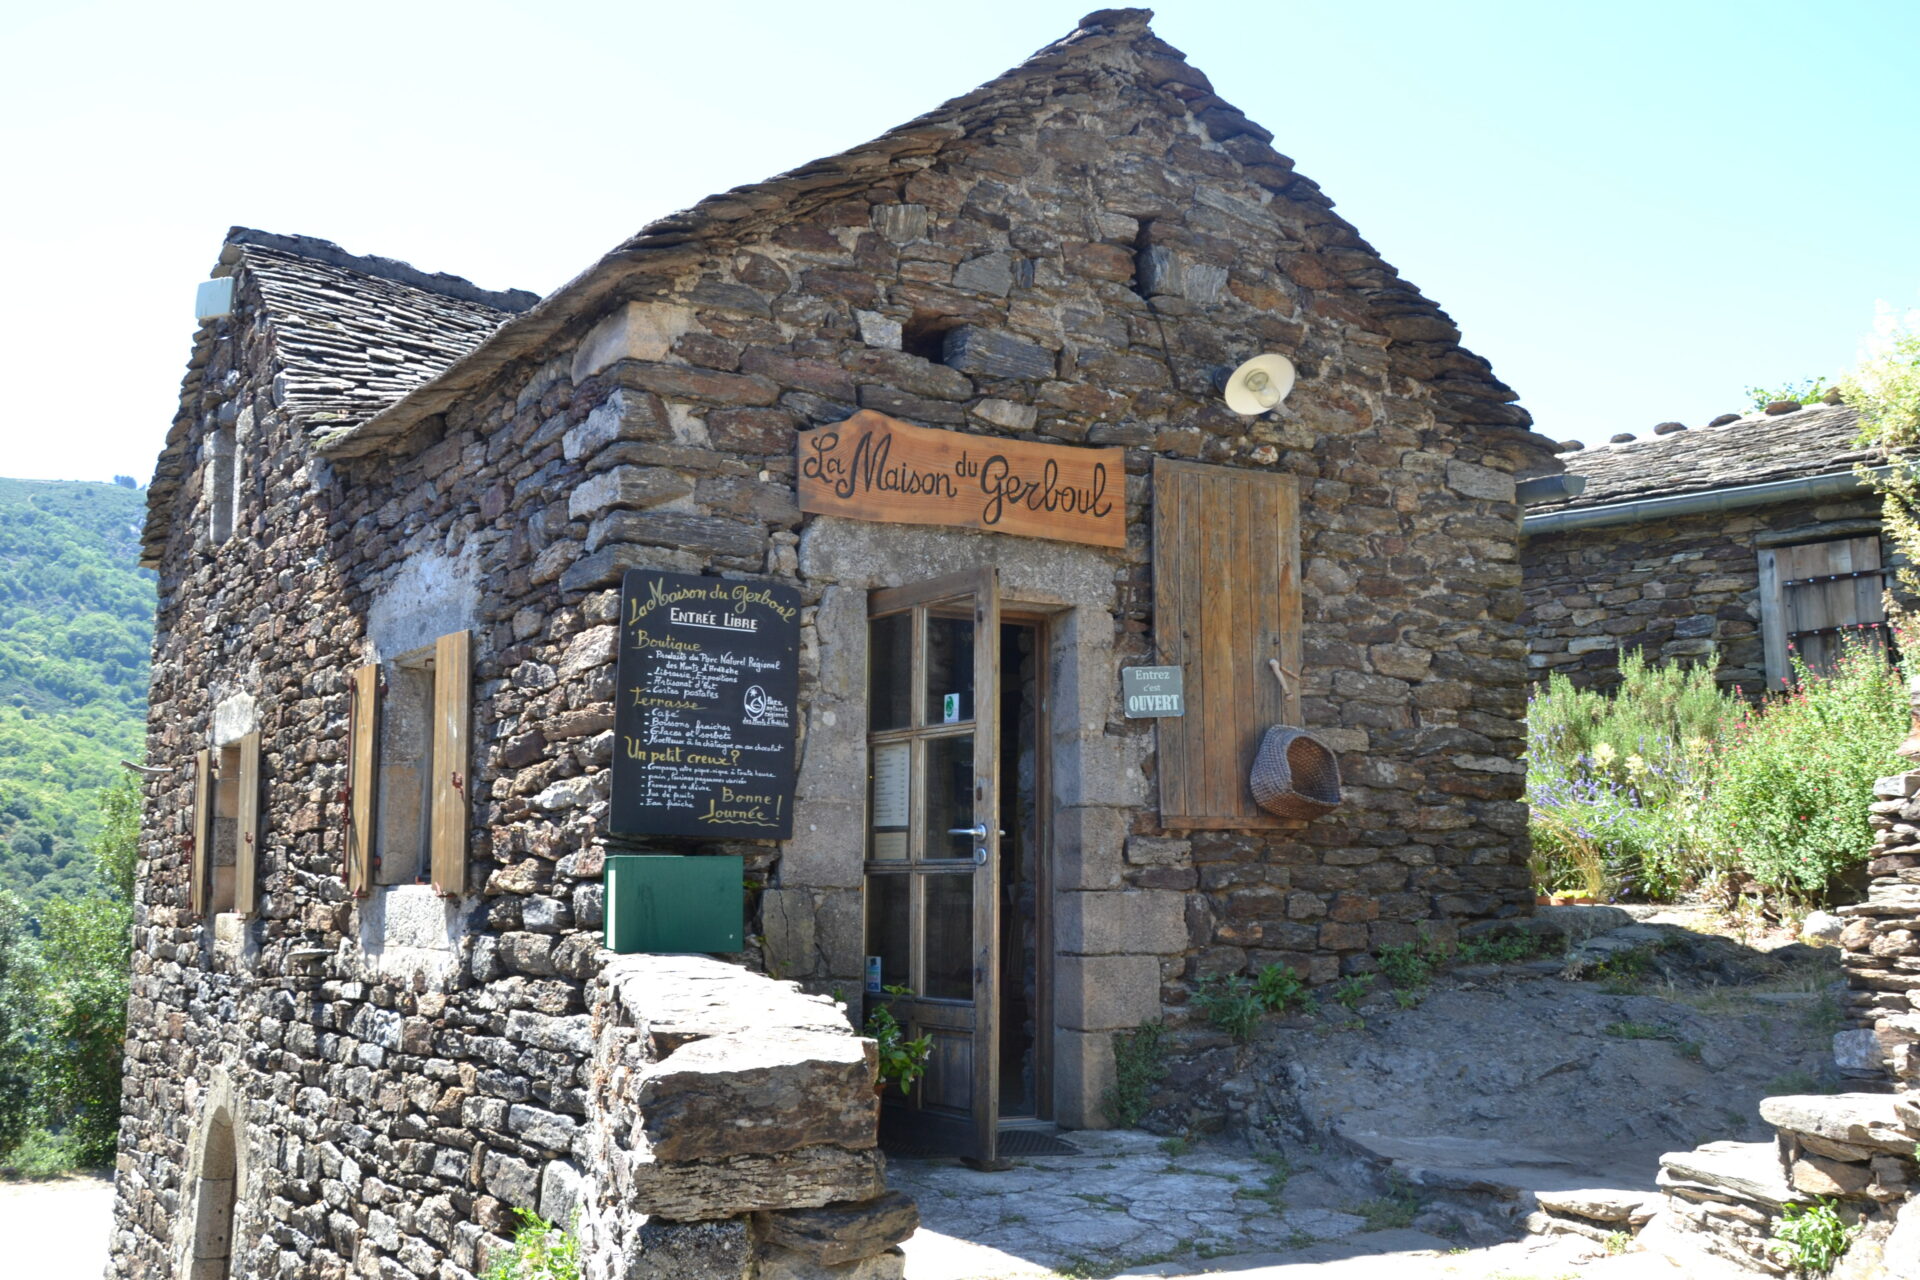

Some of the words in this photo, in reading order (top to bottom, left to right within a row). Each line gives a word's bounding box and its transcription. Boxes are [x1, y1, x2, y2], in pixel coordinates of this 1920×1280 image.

[803, 432, 846, 484] La
[835, 431, 957, 499] Maison
[955, 450, 978, 478] du
[980, 455, 1112, 525] Gerboul
[646, 577, 707, 611] Maison
[709, 584, 729, 600] du
[670, 607, 717, 626] ENTRÉE
[631, 629, 702, 653] Boutique
[665, 660, 678, 669] des
[679, 662, 699, 673] Monts
[688, 653, 699, 661] du
[699, 652, 719, 664] Parc
[720, 651, 746, 666] Naturel
[748, 656, 780, 673] Régional
[1135, 669, 1171, 680] Entrez
[652, 676, 694, 688] Artisanat
[1143, 683, 1161, 692] c'est
[629, 686, 708, 710] Terrasse
[652, 685, 680, 695] Cartes
[683, 689, 719, 699] postales
[1128, 694, 1180, 712] OUVERT
[651, 708, 680, 721] Café
[650, 717, 690, 729] Boissons
[650, 726, 682, 737] Glaces
[685, 730, 694, 738] et
[698, 731, 732, 740] sorbets
[624, 736, 646, 761] Un
[651, 747, 685, 763] petit
[754, 743, 784, 752] chocolat
[646, 788, 659, 797] Jus
[662, 790, 670, 798] de
[673, 792, 695, 801] fruits
[722, 786, 772, 805] Bonne
[645, 798, 663, 806] Eau
[698, 799, 769, 820] Journée
